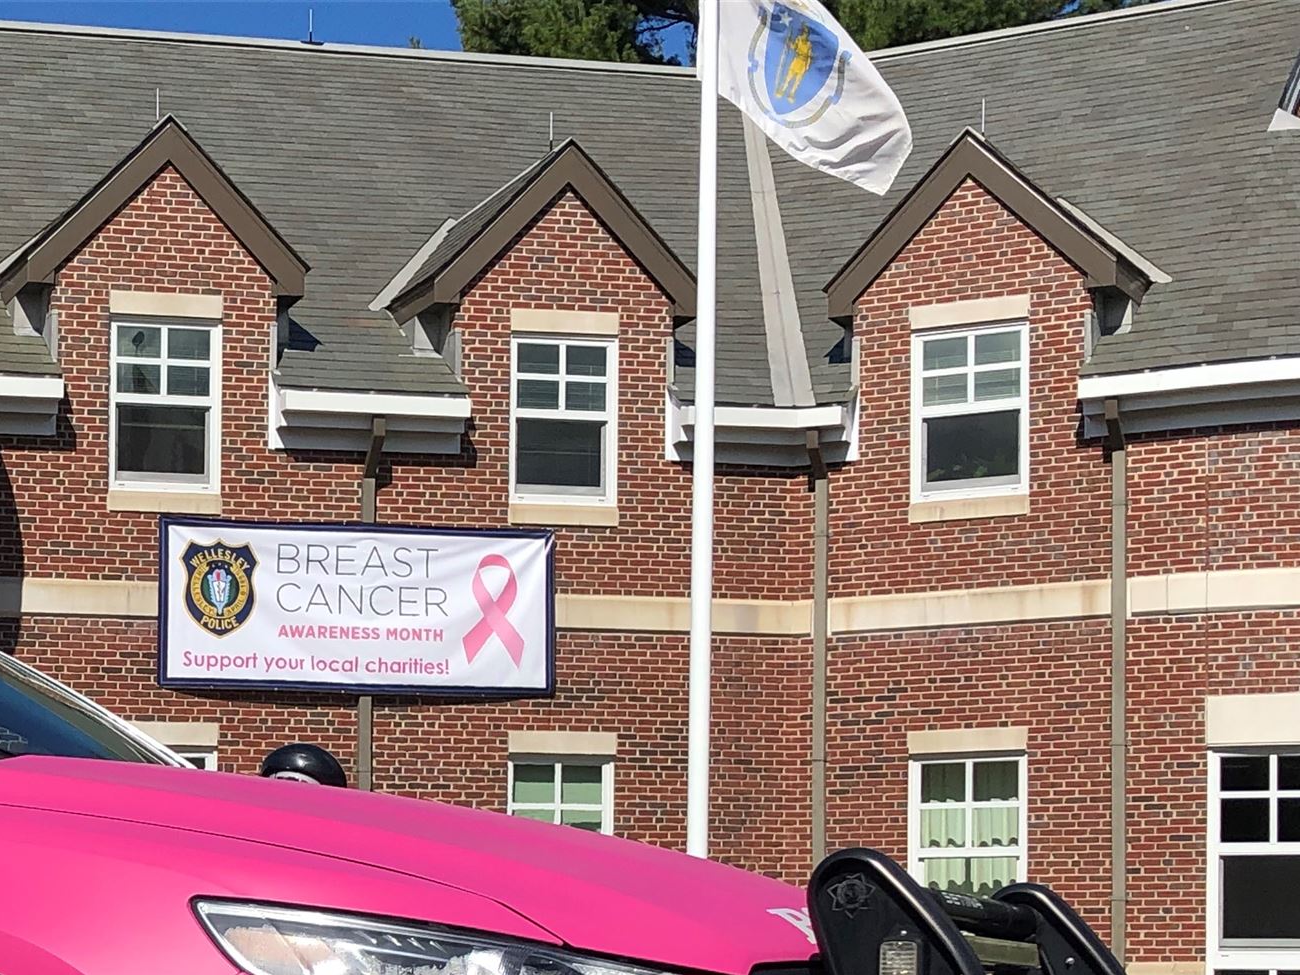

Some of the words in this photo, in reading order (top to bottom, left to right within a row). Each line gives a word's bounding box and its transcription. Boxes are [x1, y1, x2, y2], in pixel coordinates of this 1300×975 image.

[189, 548, 251, 570] WELLESLEY
[276, 543, 439, 579] BREAST
[276, 582, 449, 617] CANCER
[200, 615, 240, 630] POLICE
[277, 624, 381, 640] AWARENESS
[386, 627, 444, 642] MONTH
[182, 650, 258, 672] Support
[264, 656, 305, 673] your
[310, 656, 359, 673] local
[364, 657, 450, 675] charities!
